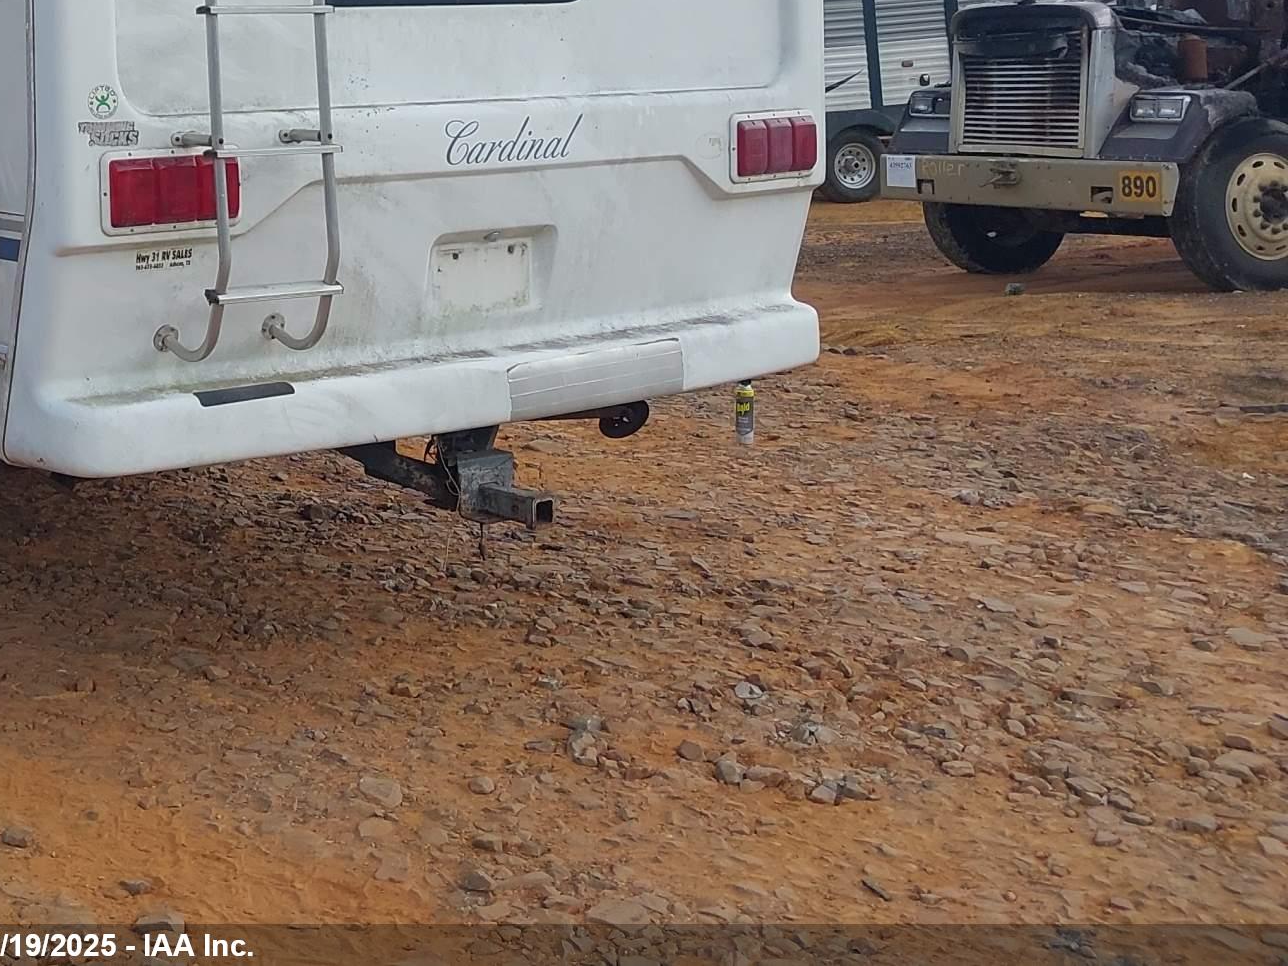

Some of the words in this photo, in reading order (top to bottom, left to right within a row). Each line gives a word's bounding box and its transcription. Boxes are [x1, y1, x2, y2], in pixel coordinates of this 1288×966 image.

[445, 113, 583, 166] Cardinal
[1121, 175, 1157, 198] 890
[135, 252, 150, 264] Hwy
[151, 251, 160, 262] 31
[161, 250, 171, 261] RV
[172, 248, 193, 260] SALES
